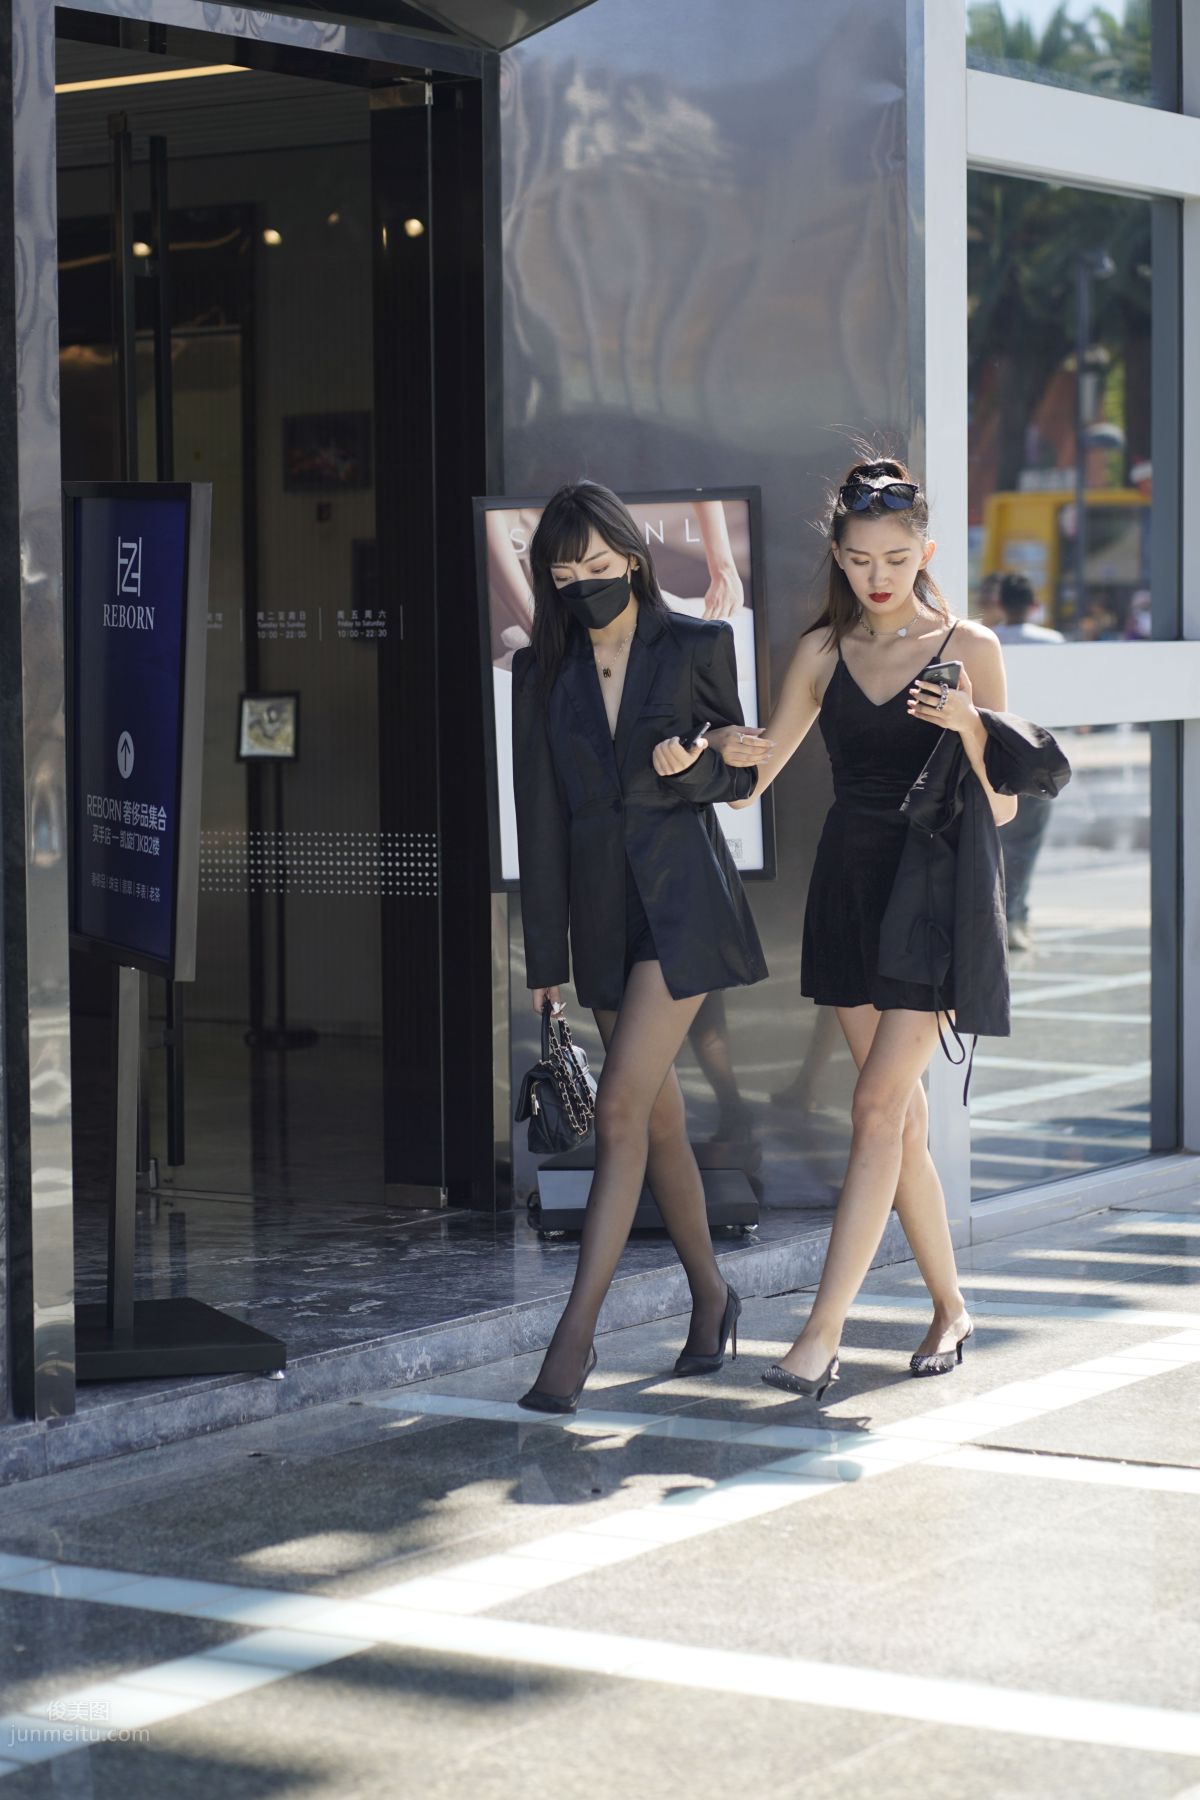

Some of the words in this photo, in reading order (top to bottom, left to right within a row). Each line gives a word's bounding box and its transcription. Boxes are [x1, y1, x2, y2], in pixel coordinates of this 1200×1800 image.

[103, 604, 155, 630] REBORN
[86, 794, 122, 821] REBORN
[122, 799, 167, 832] 奢侈品集合
